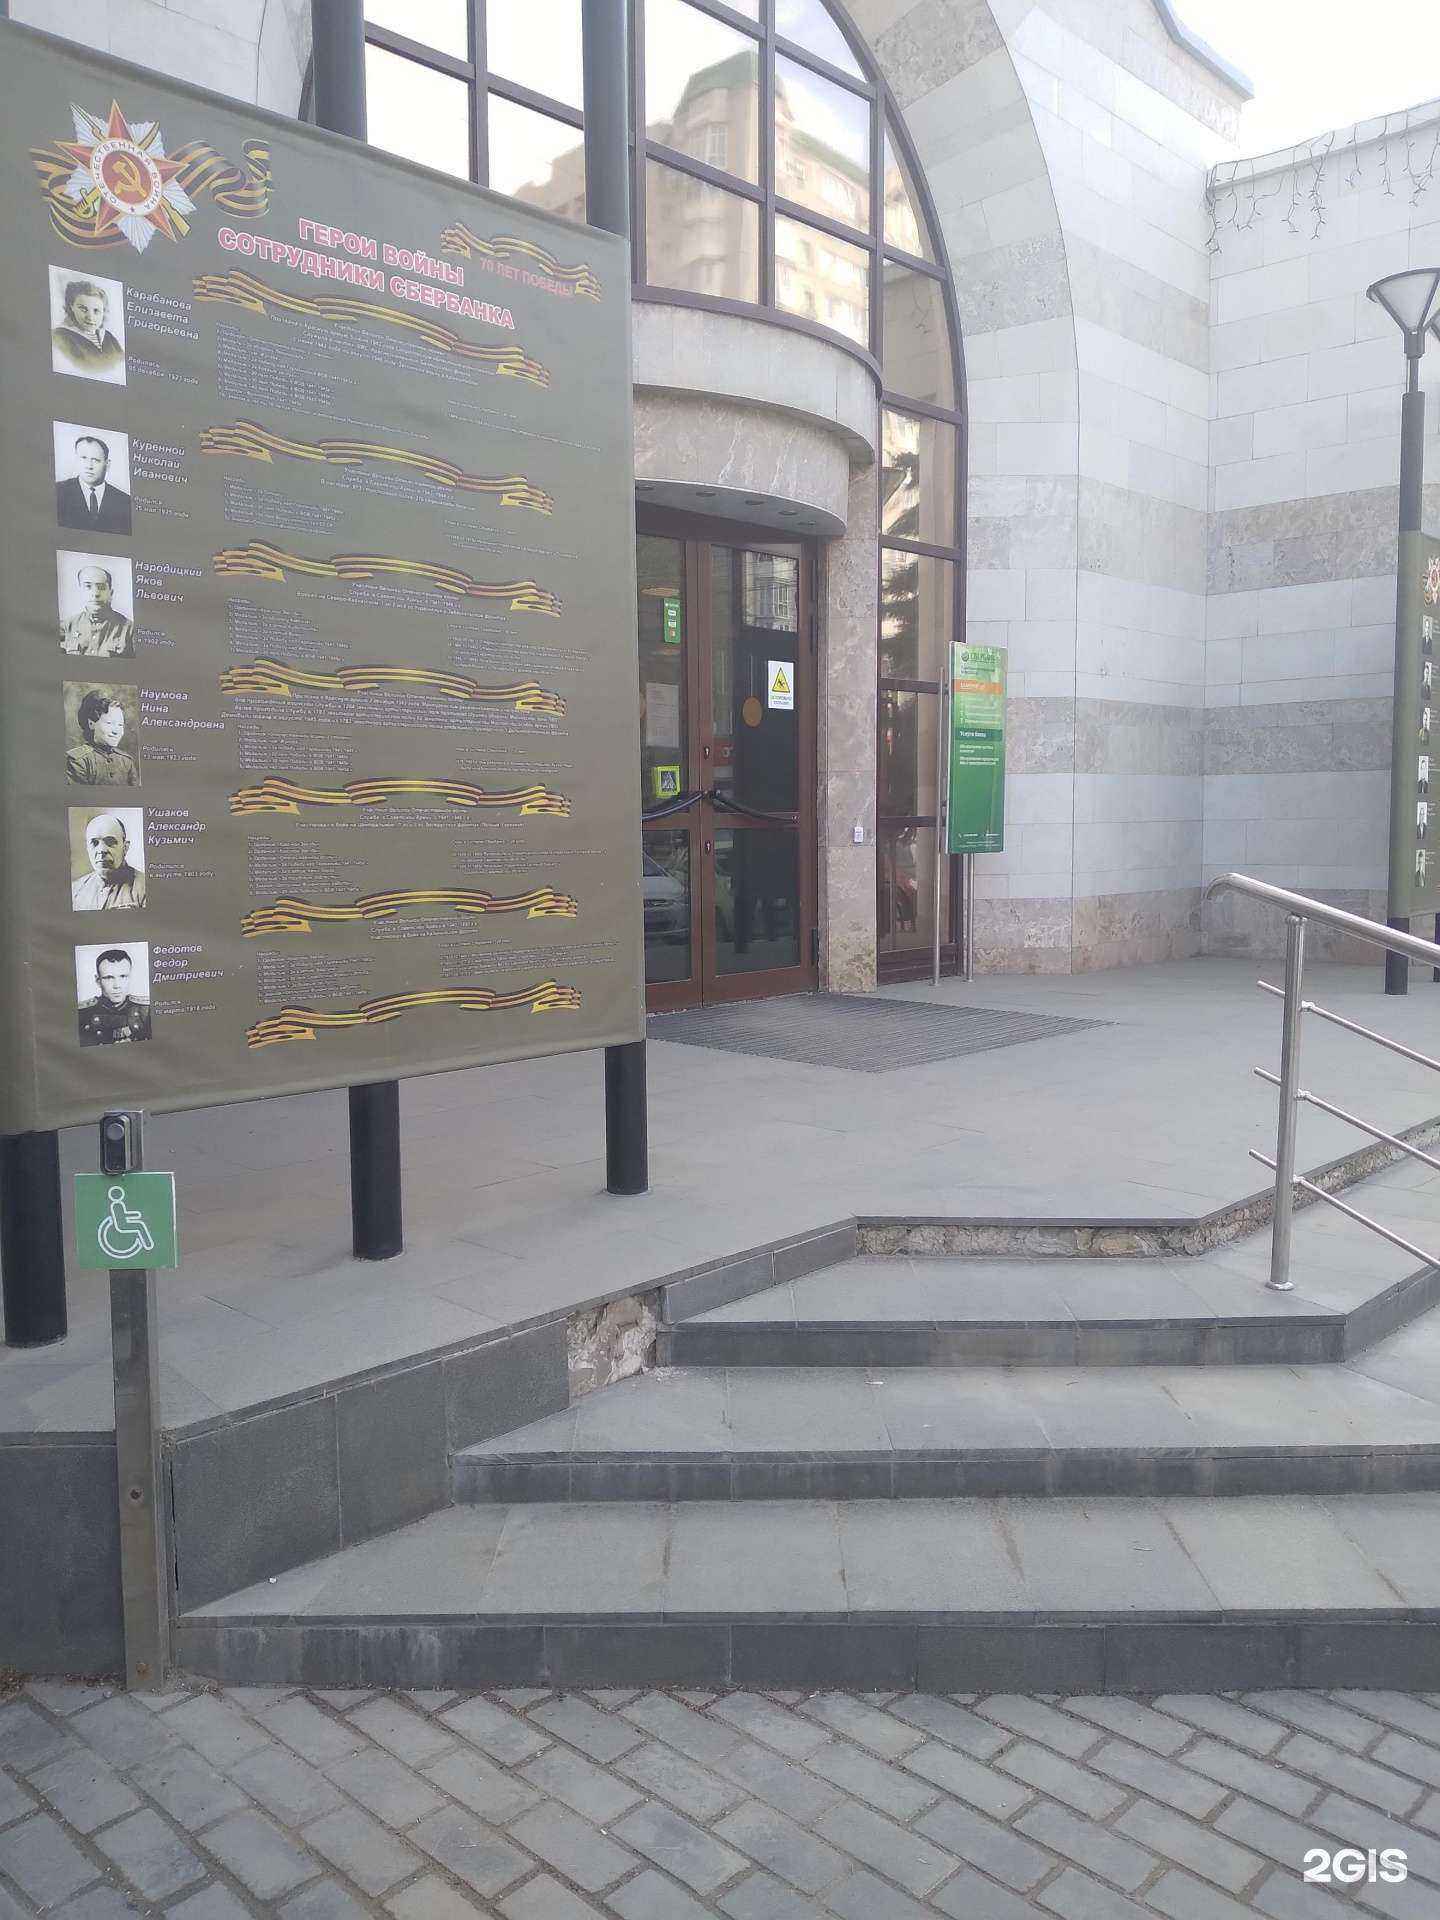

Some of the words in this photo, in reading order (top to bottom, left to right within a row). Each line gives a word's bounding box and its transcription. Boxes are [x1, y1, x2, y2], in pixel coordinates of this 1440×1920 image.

[298, 217, 378, 261] ГЕРОИ
[382, 243, 464, 287] ВОЙНЫ
[218, 227, 385, 292] СОТРУДНИКИ
[389, 276, 515, 329] СБЕРБАНКА
[494, 263, 520, 281] ЛЕТ
[126, 287, 192, 311] Карабанова
[127, 315, 199, 340] Григорьевна
[133, 466, 188, 484] Иванович
[136, 574, 163, 587] Яков
[136, 588, 184, 603] Львович
[140, 688, 188, 701] Наумова
[141, 702, 169, 713] Нина
[141, 716, 225, 730] Александровна
[147, 807, 189, 818] Ушаков
[147, 821, 206, 832] Александр
[148, 835, 194, 847] Кузьмич
[153, 944, 202, 954] Федотов
[153, 958, 188, 969] Федор
[152, 969, 224, 984] Дмитриевич
